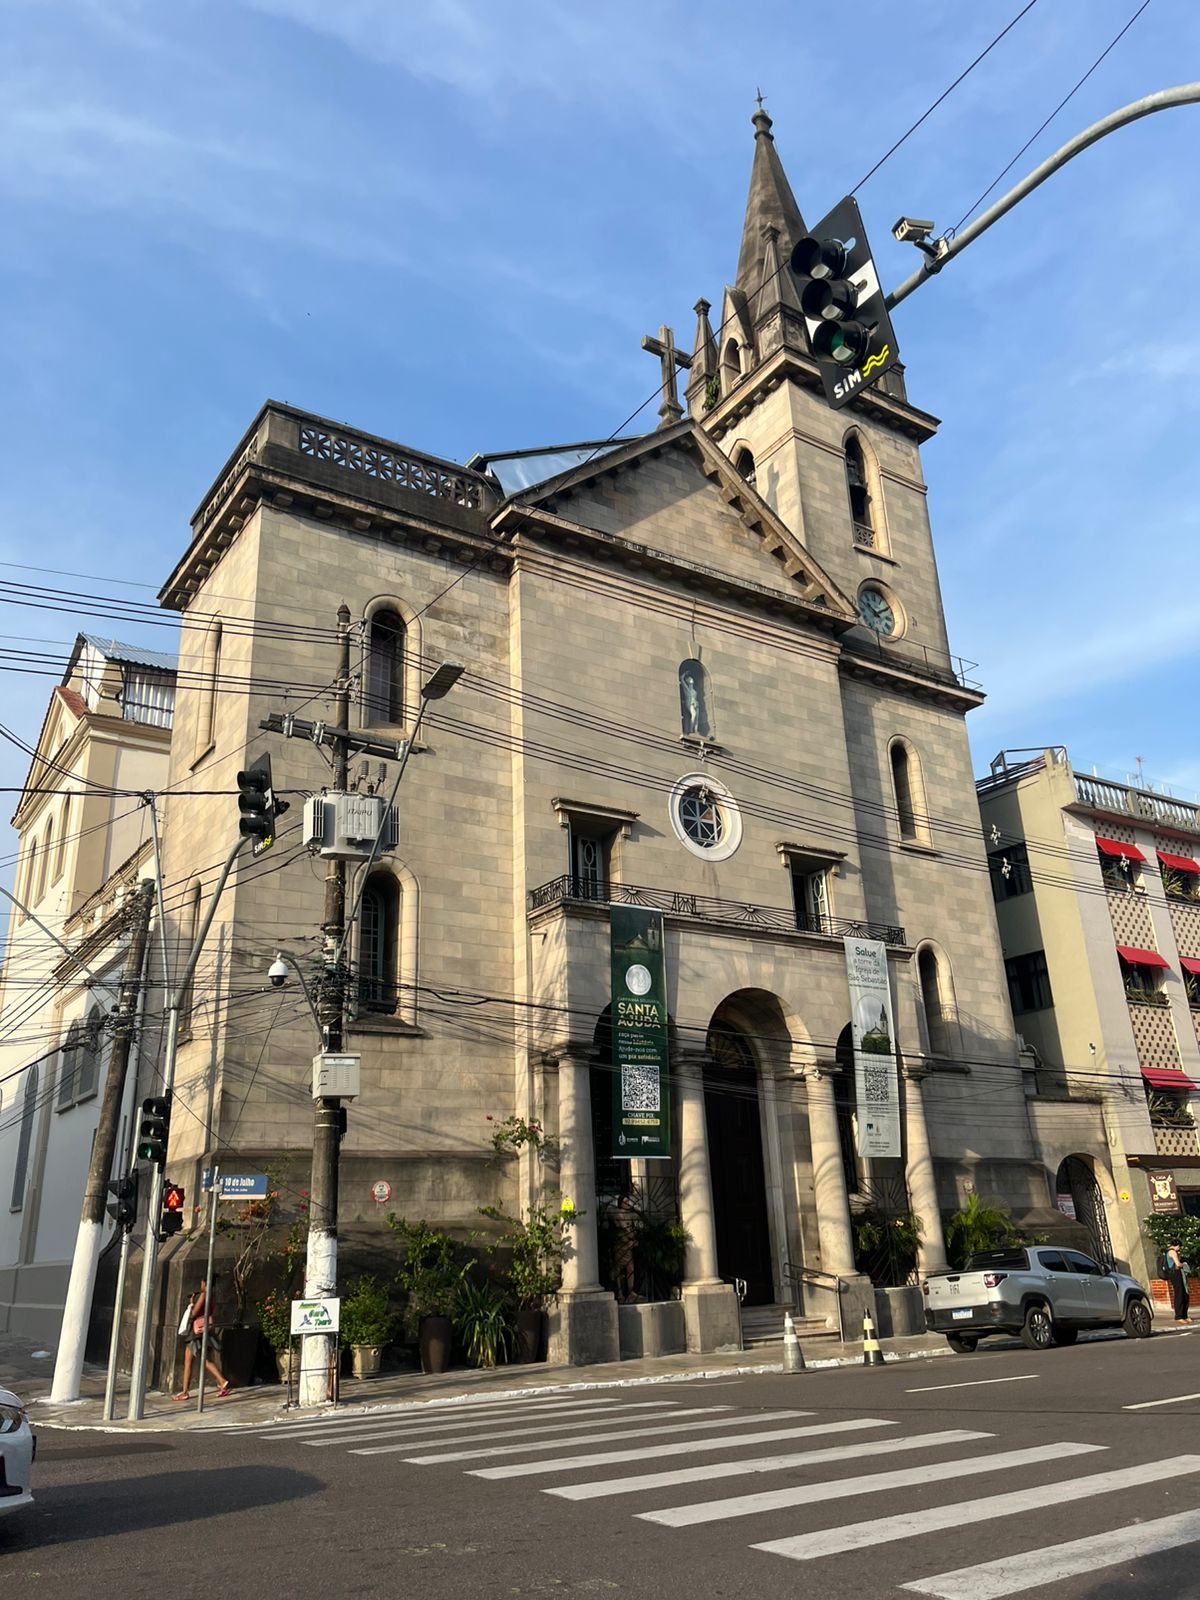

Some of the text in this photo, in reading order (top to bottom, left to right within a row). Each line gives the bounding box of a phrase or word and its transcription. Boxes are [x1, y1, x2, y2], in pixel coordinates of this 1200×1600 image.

[833, 368, 863, 400] SIM
[855, 946, 877, 958] Salve
[618, 1002, 659, 1017] SANTA
[617, 1014, 661, 1029] AJUDA
[225, 1177, 232, 1187] 10
[232, 1177, 240, 1187] de
[240, 1177, 255, 1187] Julho
